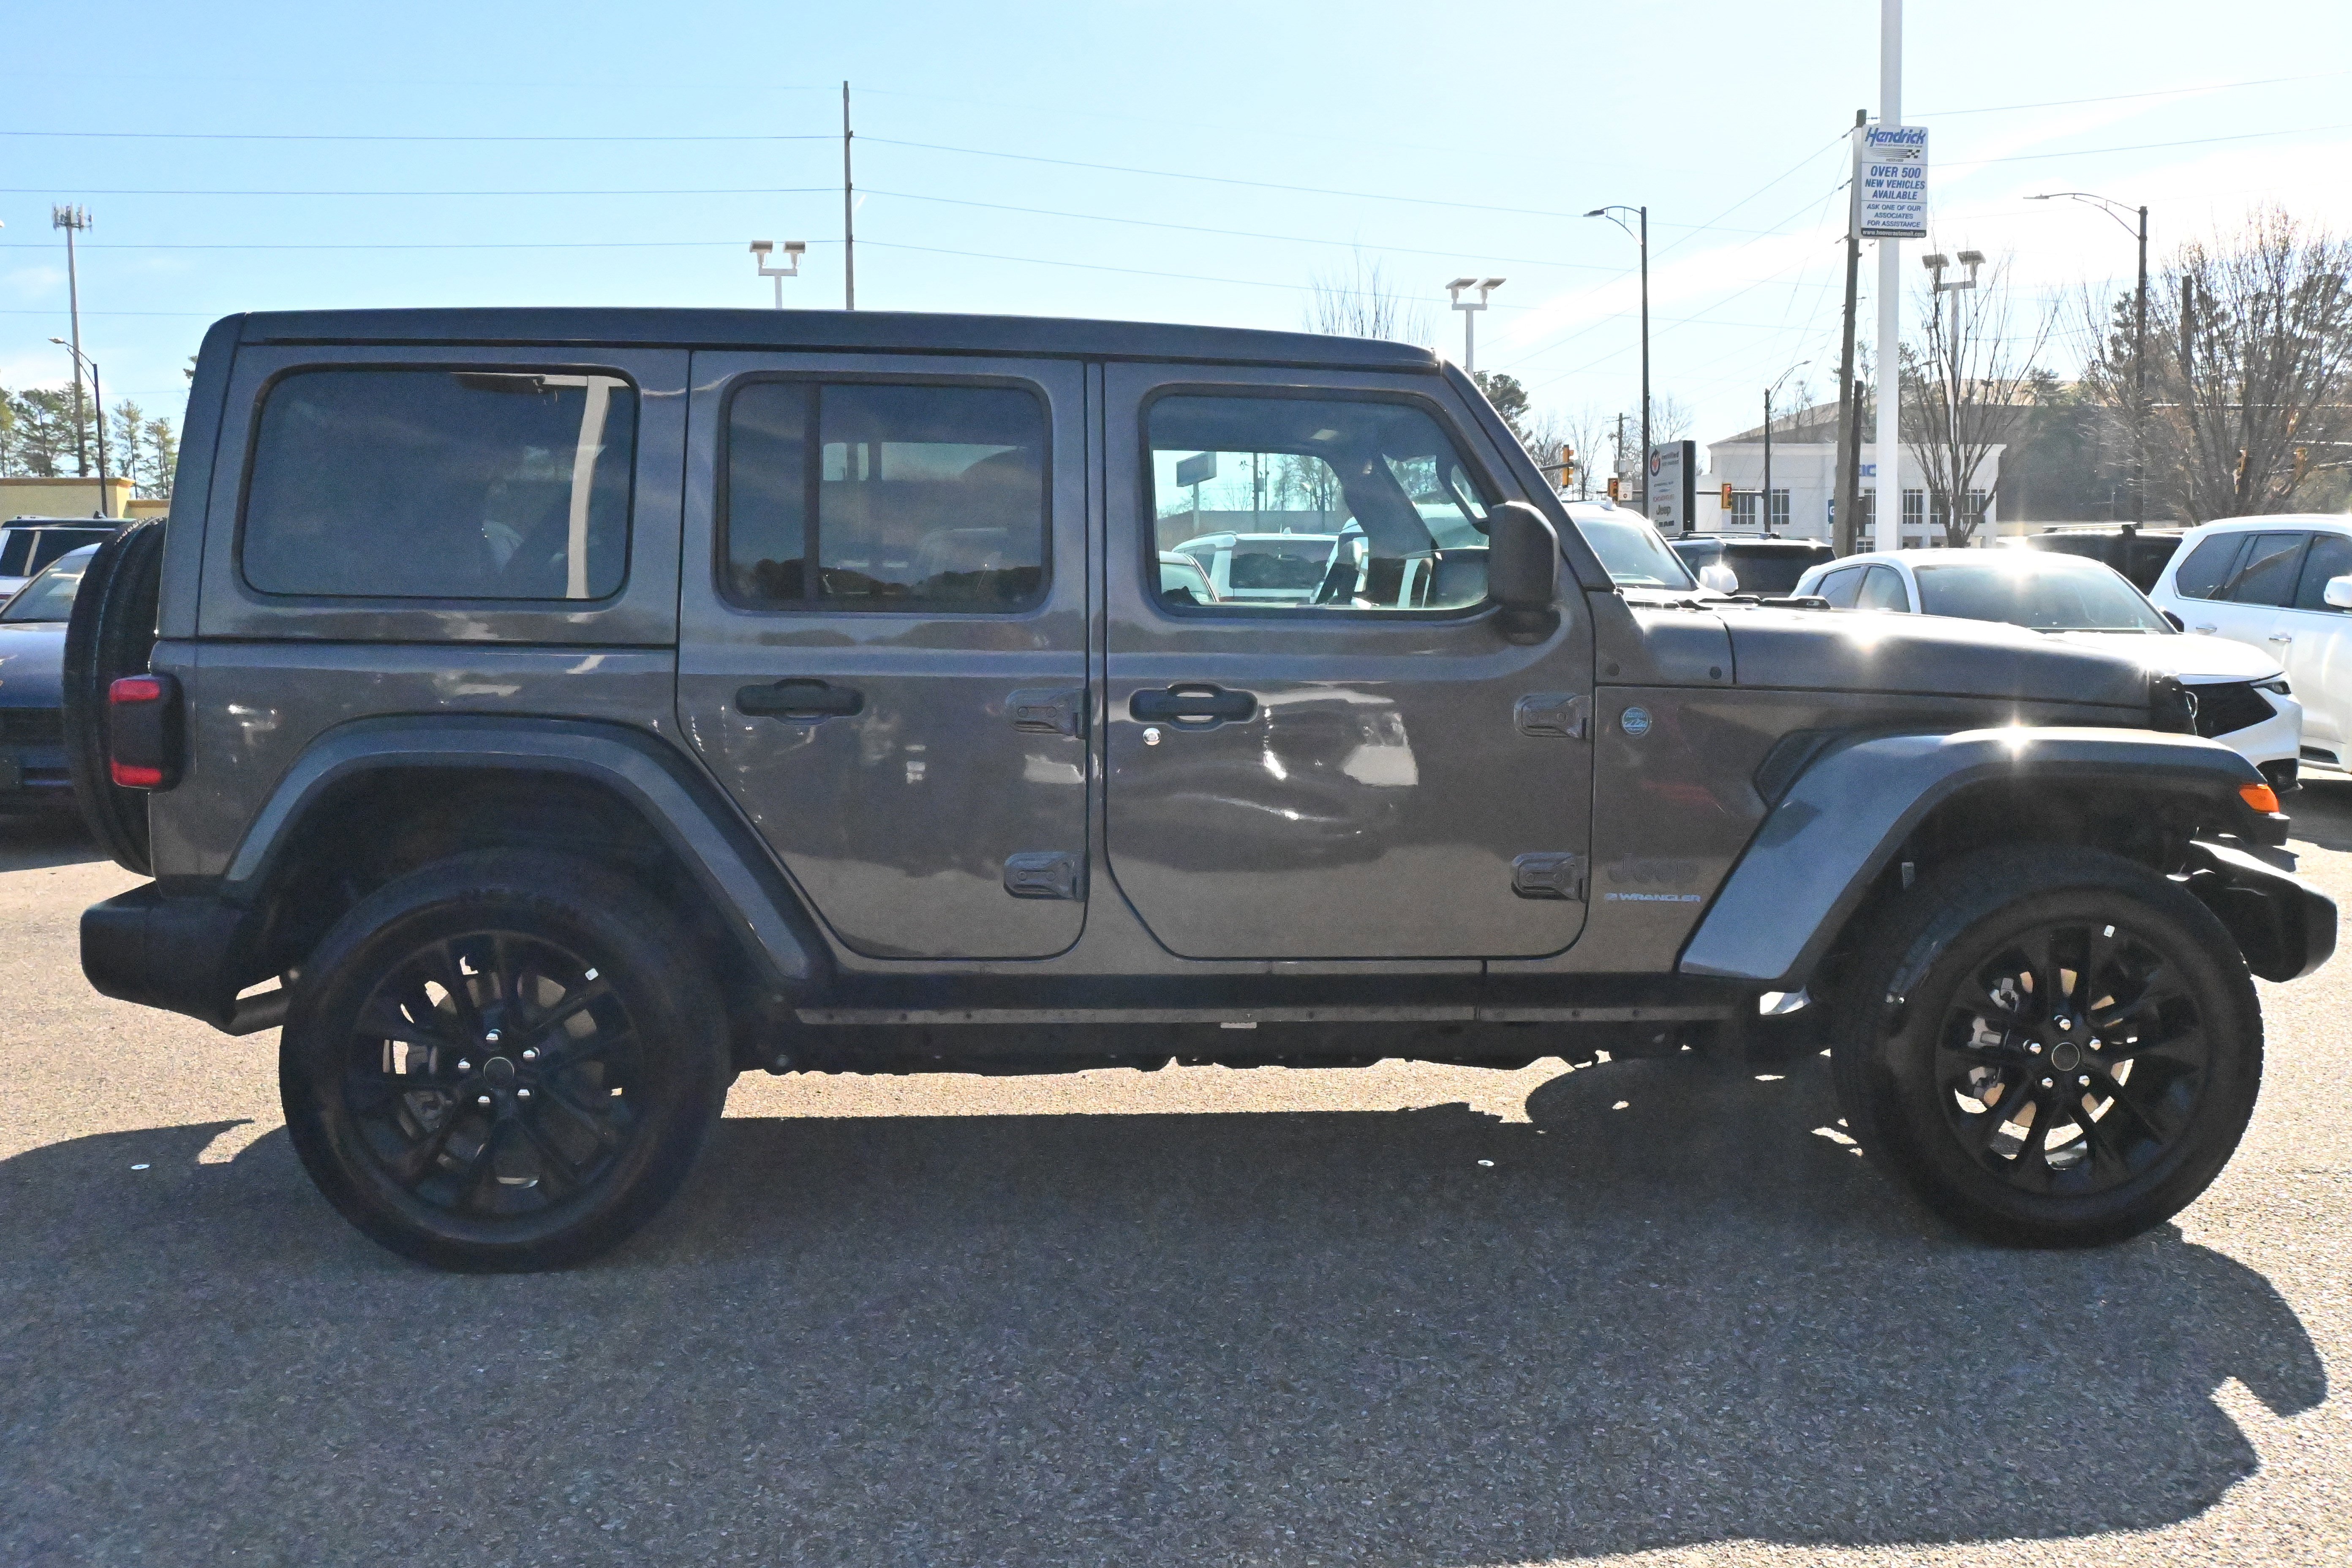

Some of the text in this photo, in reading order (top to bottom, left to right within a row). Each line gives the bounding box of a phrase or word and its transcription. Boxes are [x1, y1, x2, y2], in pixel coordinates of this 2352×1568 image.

[1865, 127, 1926, 147] Hendrick
[1870, 165, 1921, 178] OVER 500
[1865, 179, 1925, 189] NEW VEHICLES
[1872, 190, 1918, 200] AVAILABLE
[1653, 494, 1674, 502] DODGE
[1656, 505, 1671, 516] Jeep
[1608, 853, 1699, 889] Jeep
[1619, 893, 1701, 902] WRANGLER
